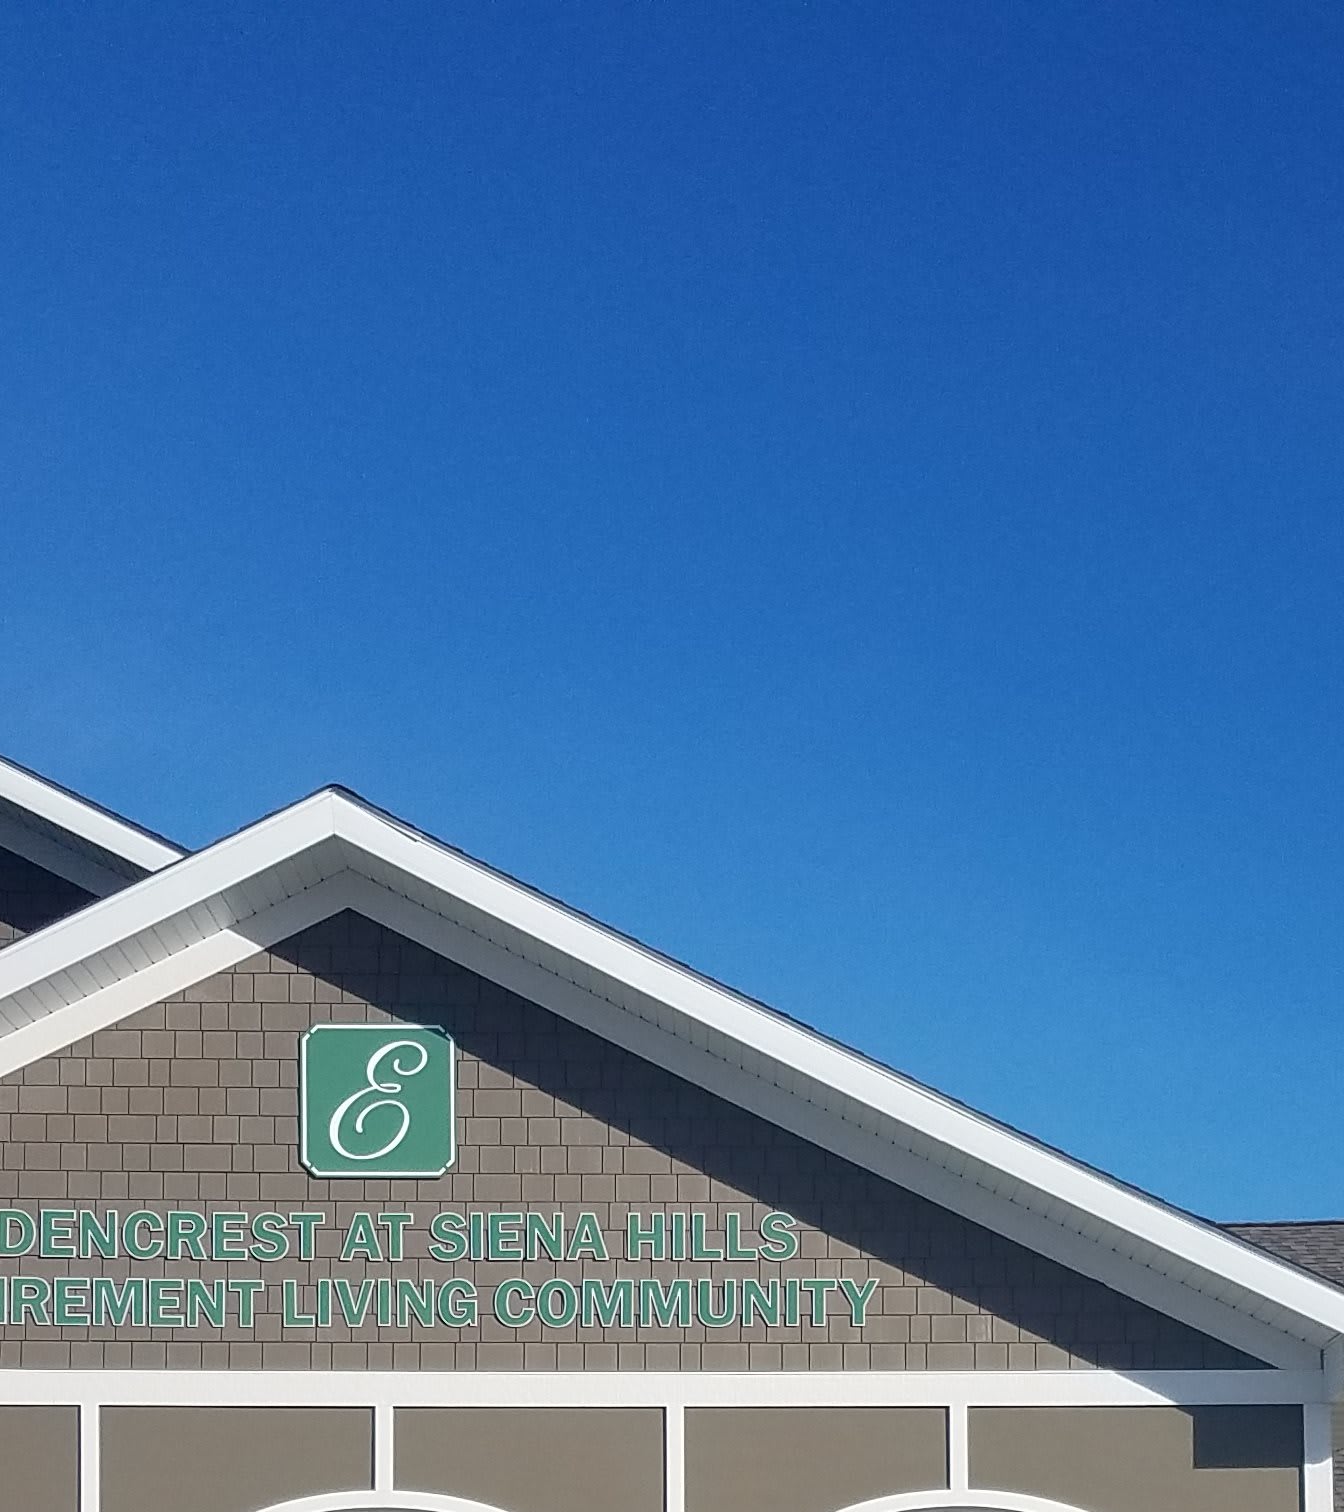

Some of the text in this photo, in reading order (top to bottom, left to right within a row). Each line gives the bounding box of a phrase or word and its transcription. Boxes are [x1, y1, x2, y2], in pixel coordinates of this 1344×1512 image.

[329, 1040, 428, 1160] E
[339, 1211, 414, 1262] AT
[428, 1211, 610, 1262] SIENA
[626, 1211, 799, 1262] HILLS
[281, 1278, 479, 1329] LIVING
[493, 1278, 881, 1329] COMMUNITY
